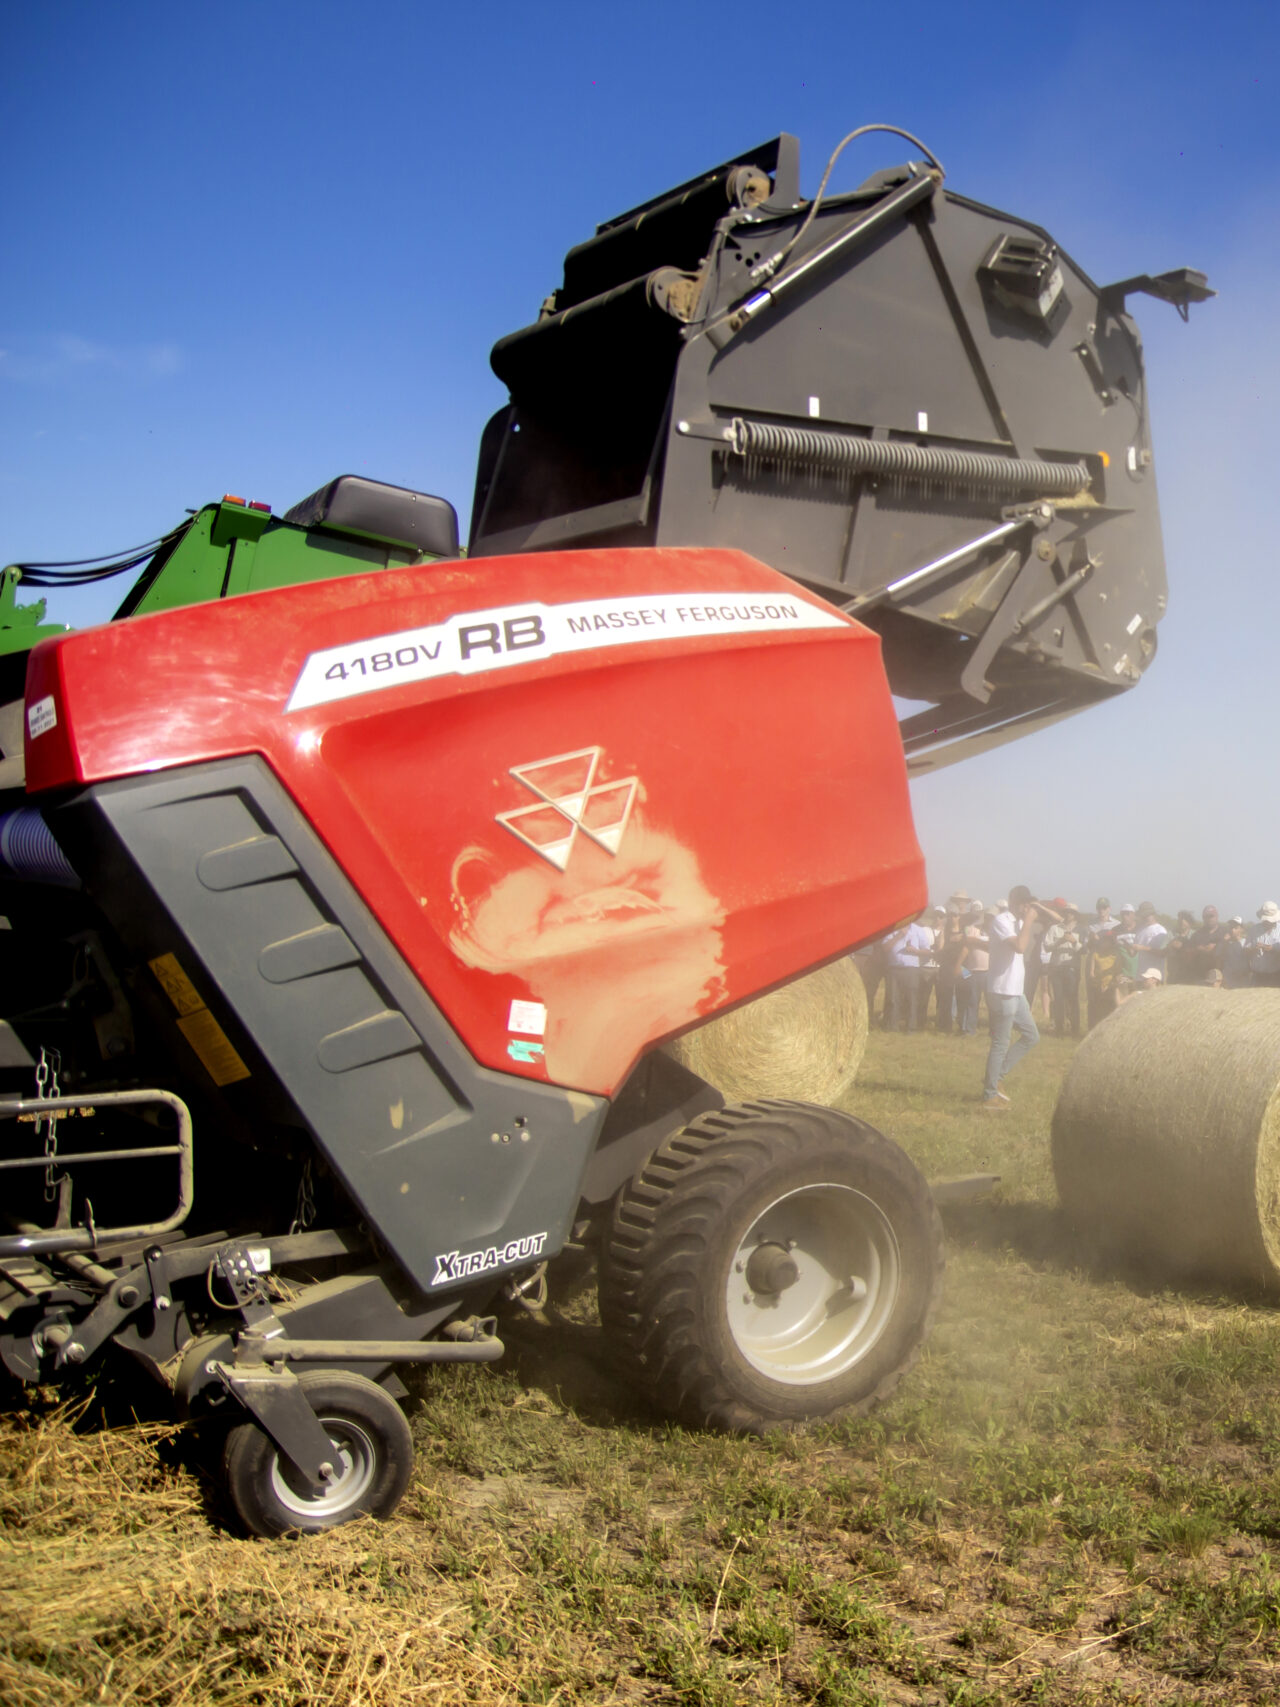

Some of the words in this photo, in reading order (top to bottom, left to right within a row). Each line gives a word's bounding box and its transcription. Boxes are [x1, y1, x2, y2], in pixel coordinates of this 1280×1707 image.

[325, 641, 442, 680] 4180V
[458, 615, 546, 660] RB
[566, 608, 667, 634] MASSEY
[676, 605, 799, 622] FERGUSON
